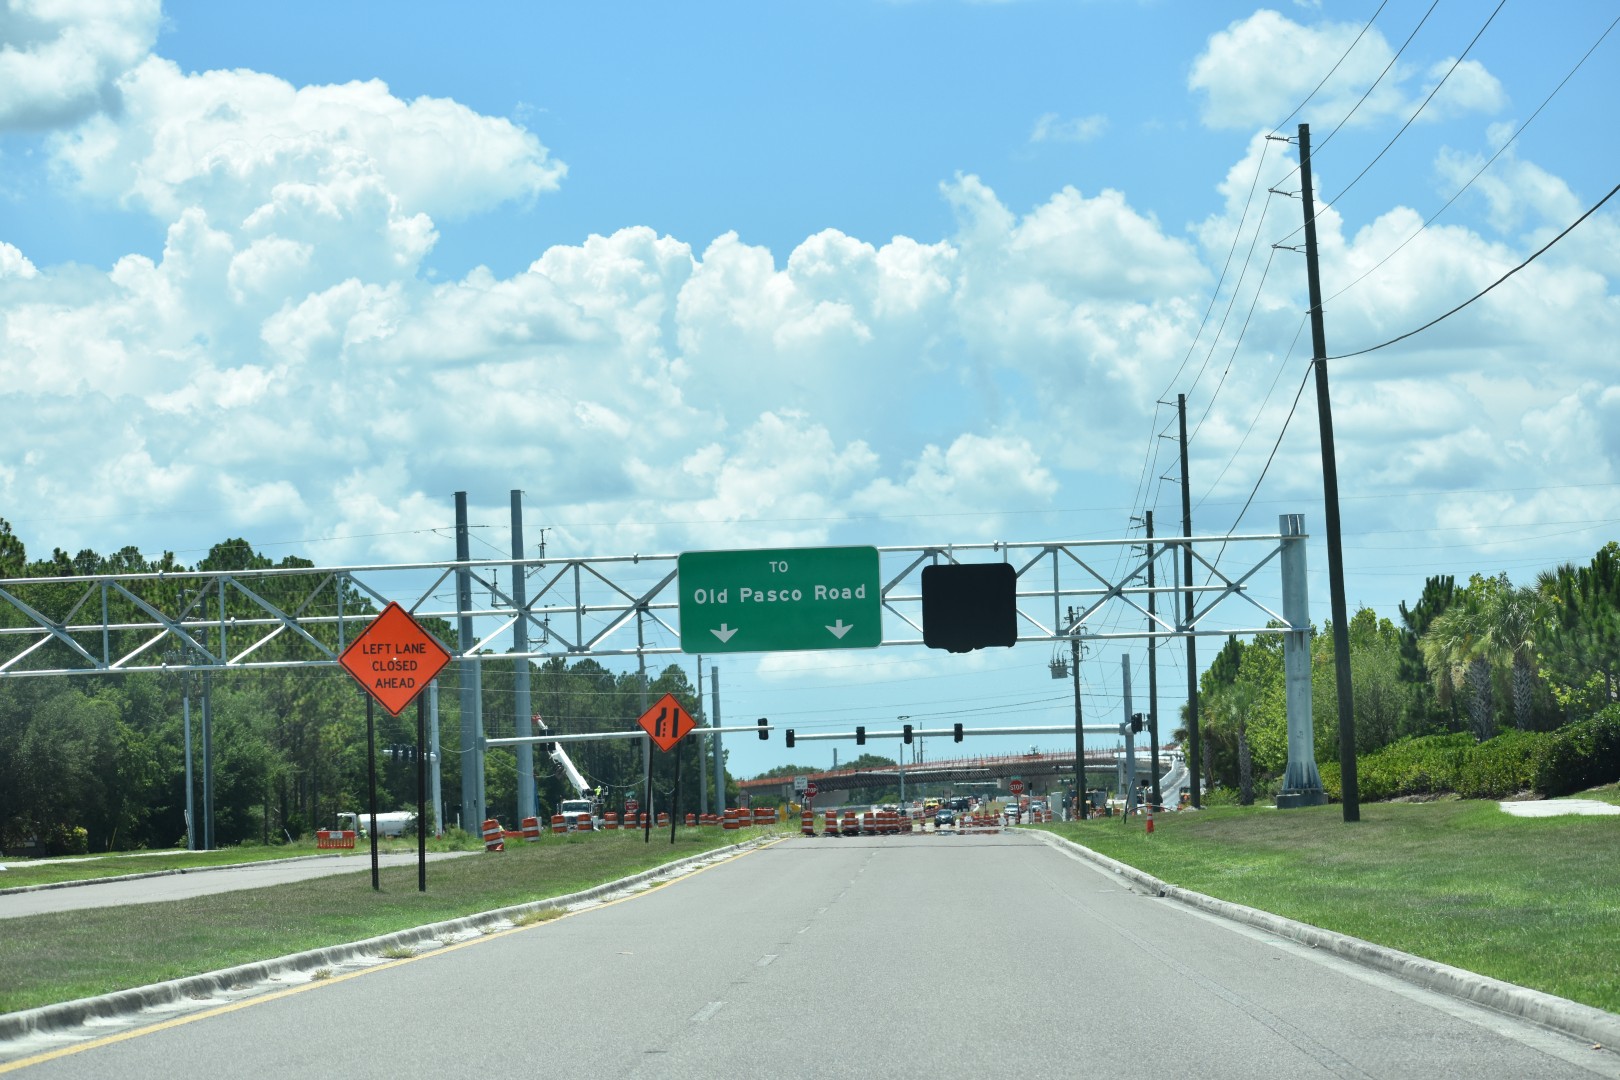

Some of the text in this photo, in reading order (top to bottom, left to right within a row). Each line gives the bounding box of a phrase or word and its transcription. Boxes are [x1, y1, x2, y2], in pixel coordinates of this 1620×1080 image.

[769, 561, 788, 573] TO
[694, 584, 866, 604] Old Pasco Road
[363, 643, 426, 654] LEFT LANE
[372, 660, 418, 671] CLOSED
[376, 678, 415, 688] AHEAD
